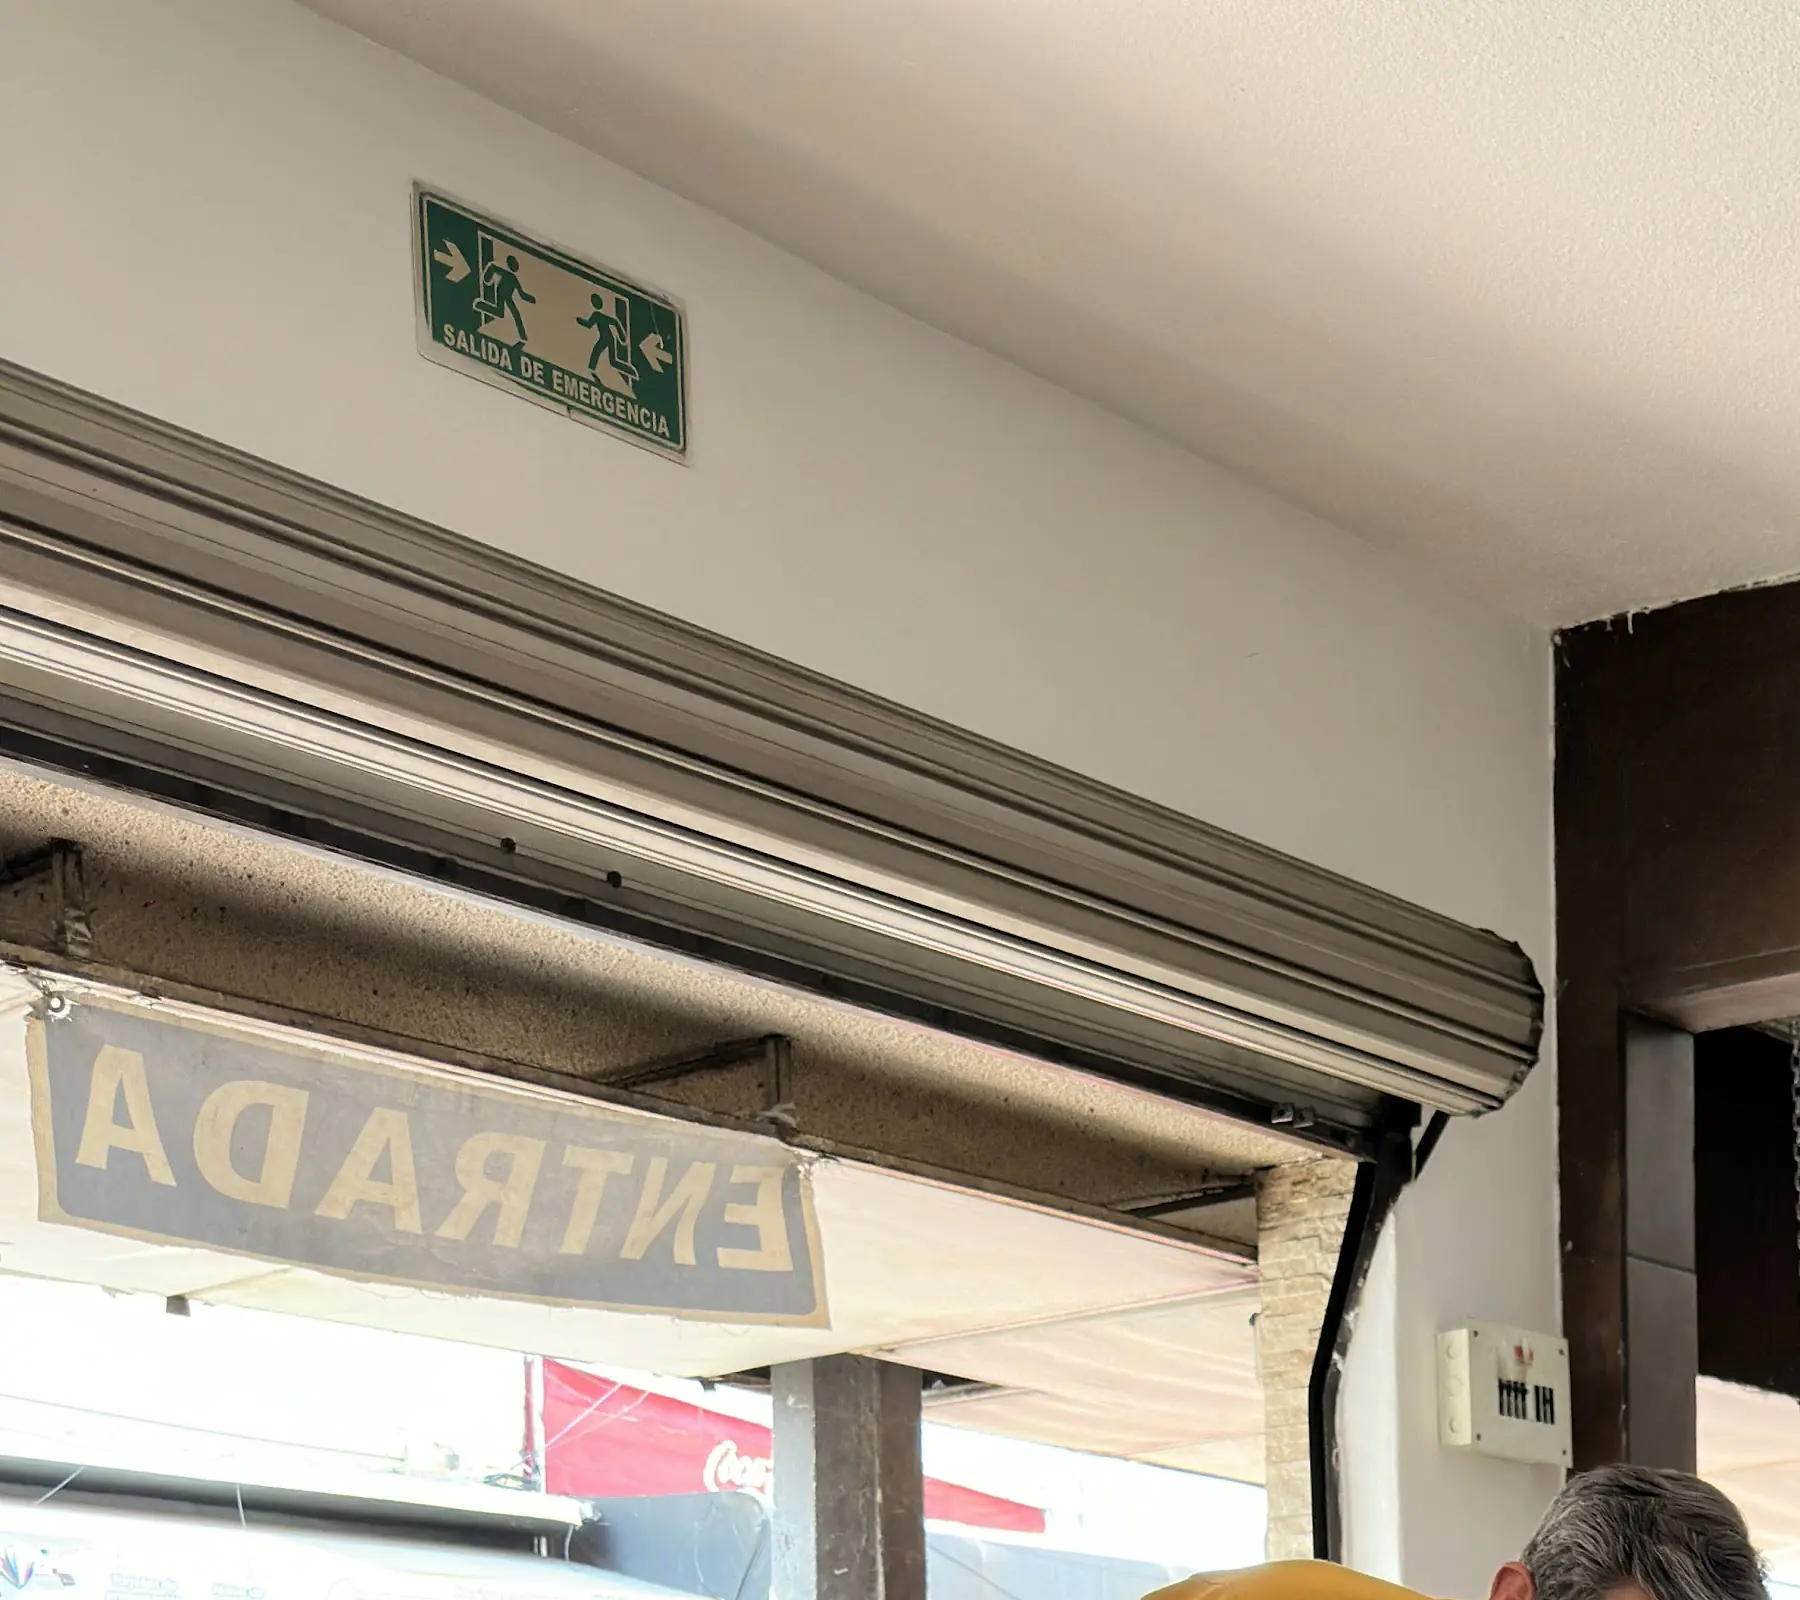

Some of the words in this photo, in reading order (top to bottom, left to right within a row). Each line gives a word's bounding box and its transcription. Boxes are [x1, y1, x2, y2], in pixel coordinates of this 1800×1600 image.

[442, 323, 513, 371] SALIDA
[520, 356, 545, 385] DE
[551, 370, 671, 438] EMERGENCIA
